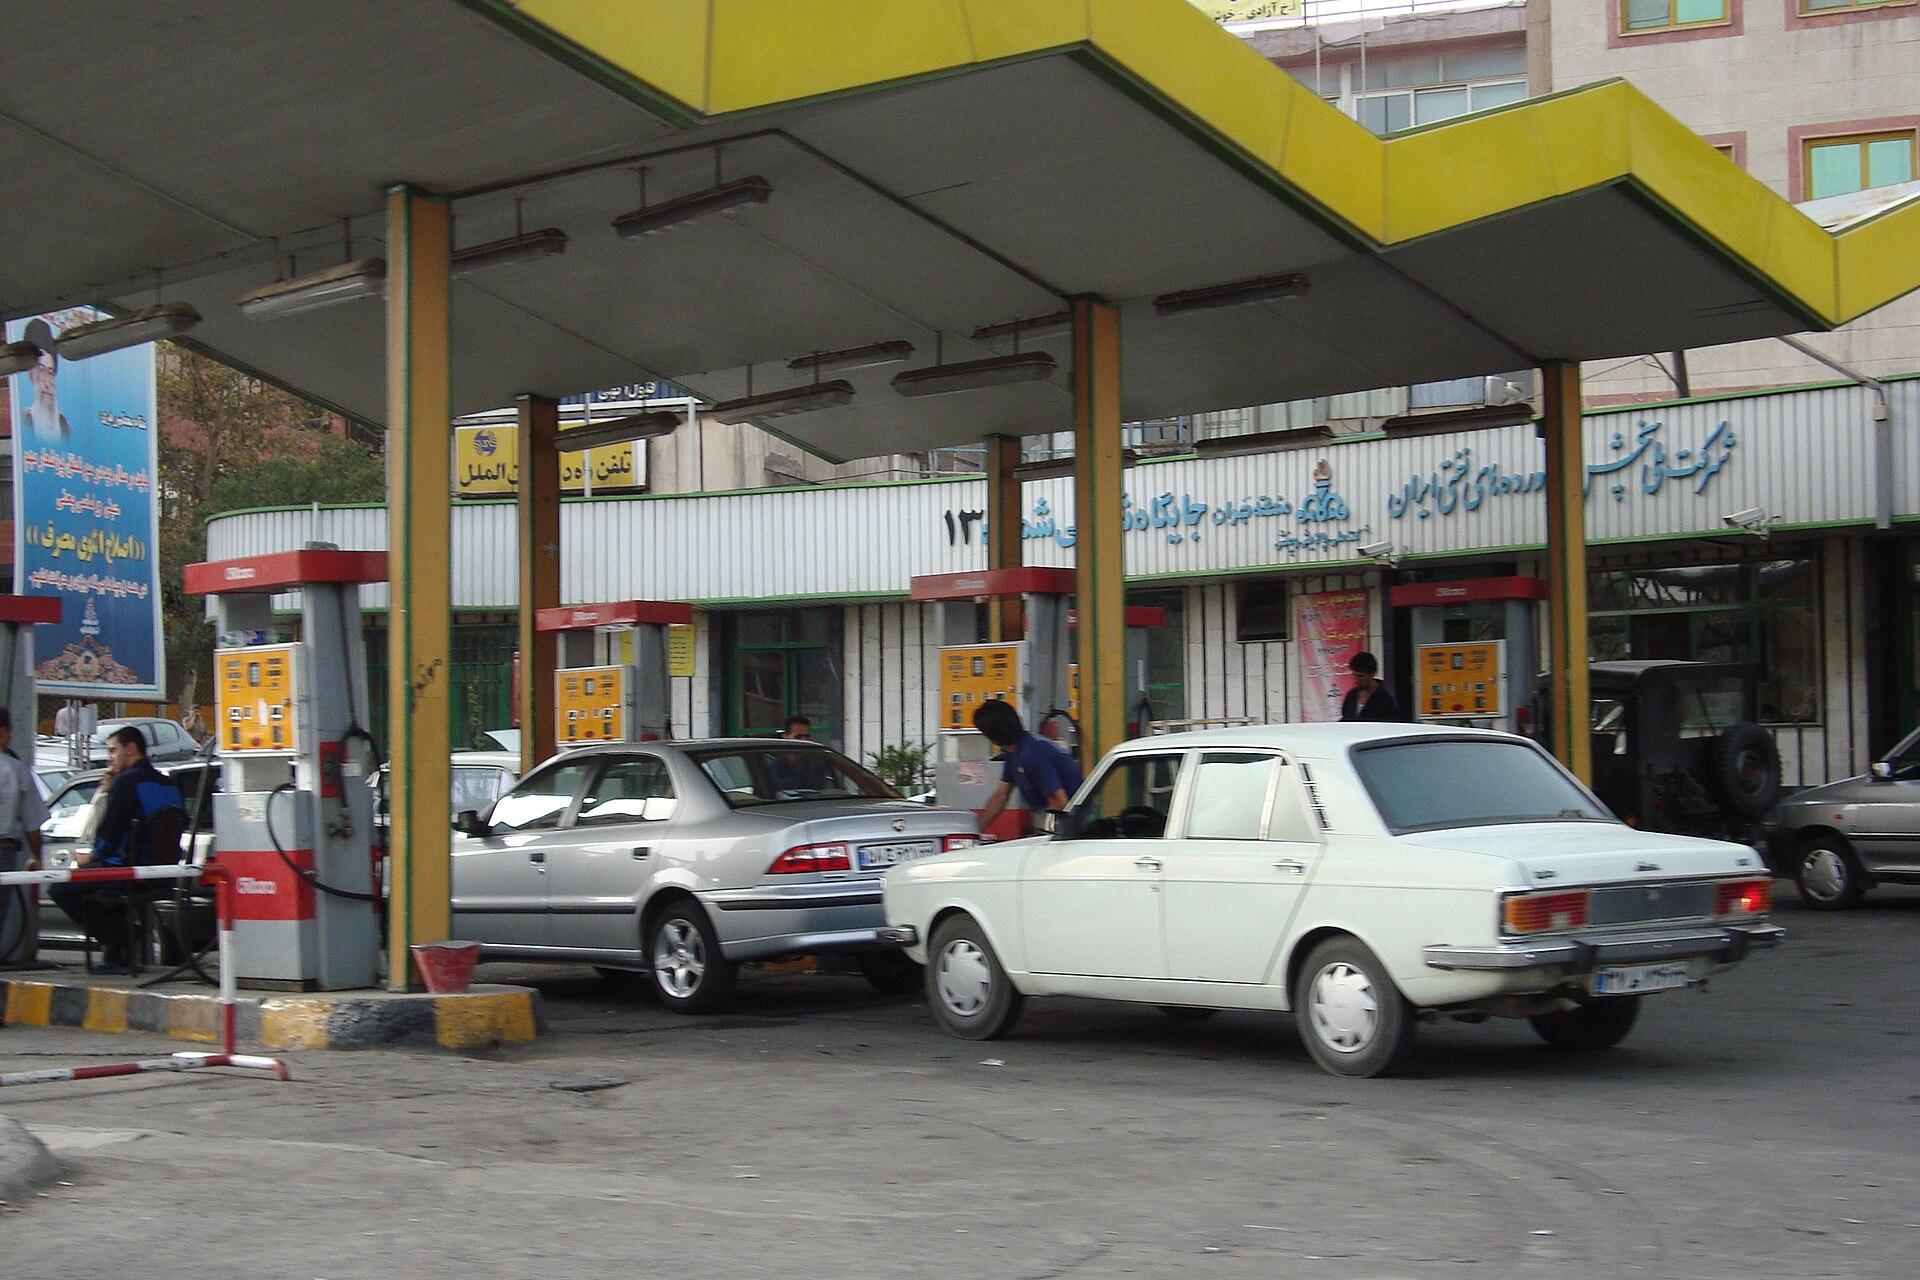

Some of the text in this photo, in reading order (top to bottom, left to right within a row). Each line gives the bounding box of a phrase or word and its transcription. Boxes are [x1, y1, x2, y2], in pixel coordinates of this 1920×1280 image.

[459, 461, 507, 488] الملل
[597, 449, 633, 481] تلفن
[1641, 441, 1666, 494] ملی
[1662, 420, 1737, 495] شرکت
[1131, 491, 1208, 545] جایگاه
[1387, 472, 1438, 520] ایران
[944, 508, 985, 547] ۱۳
